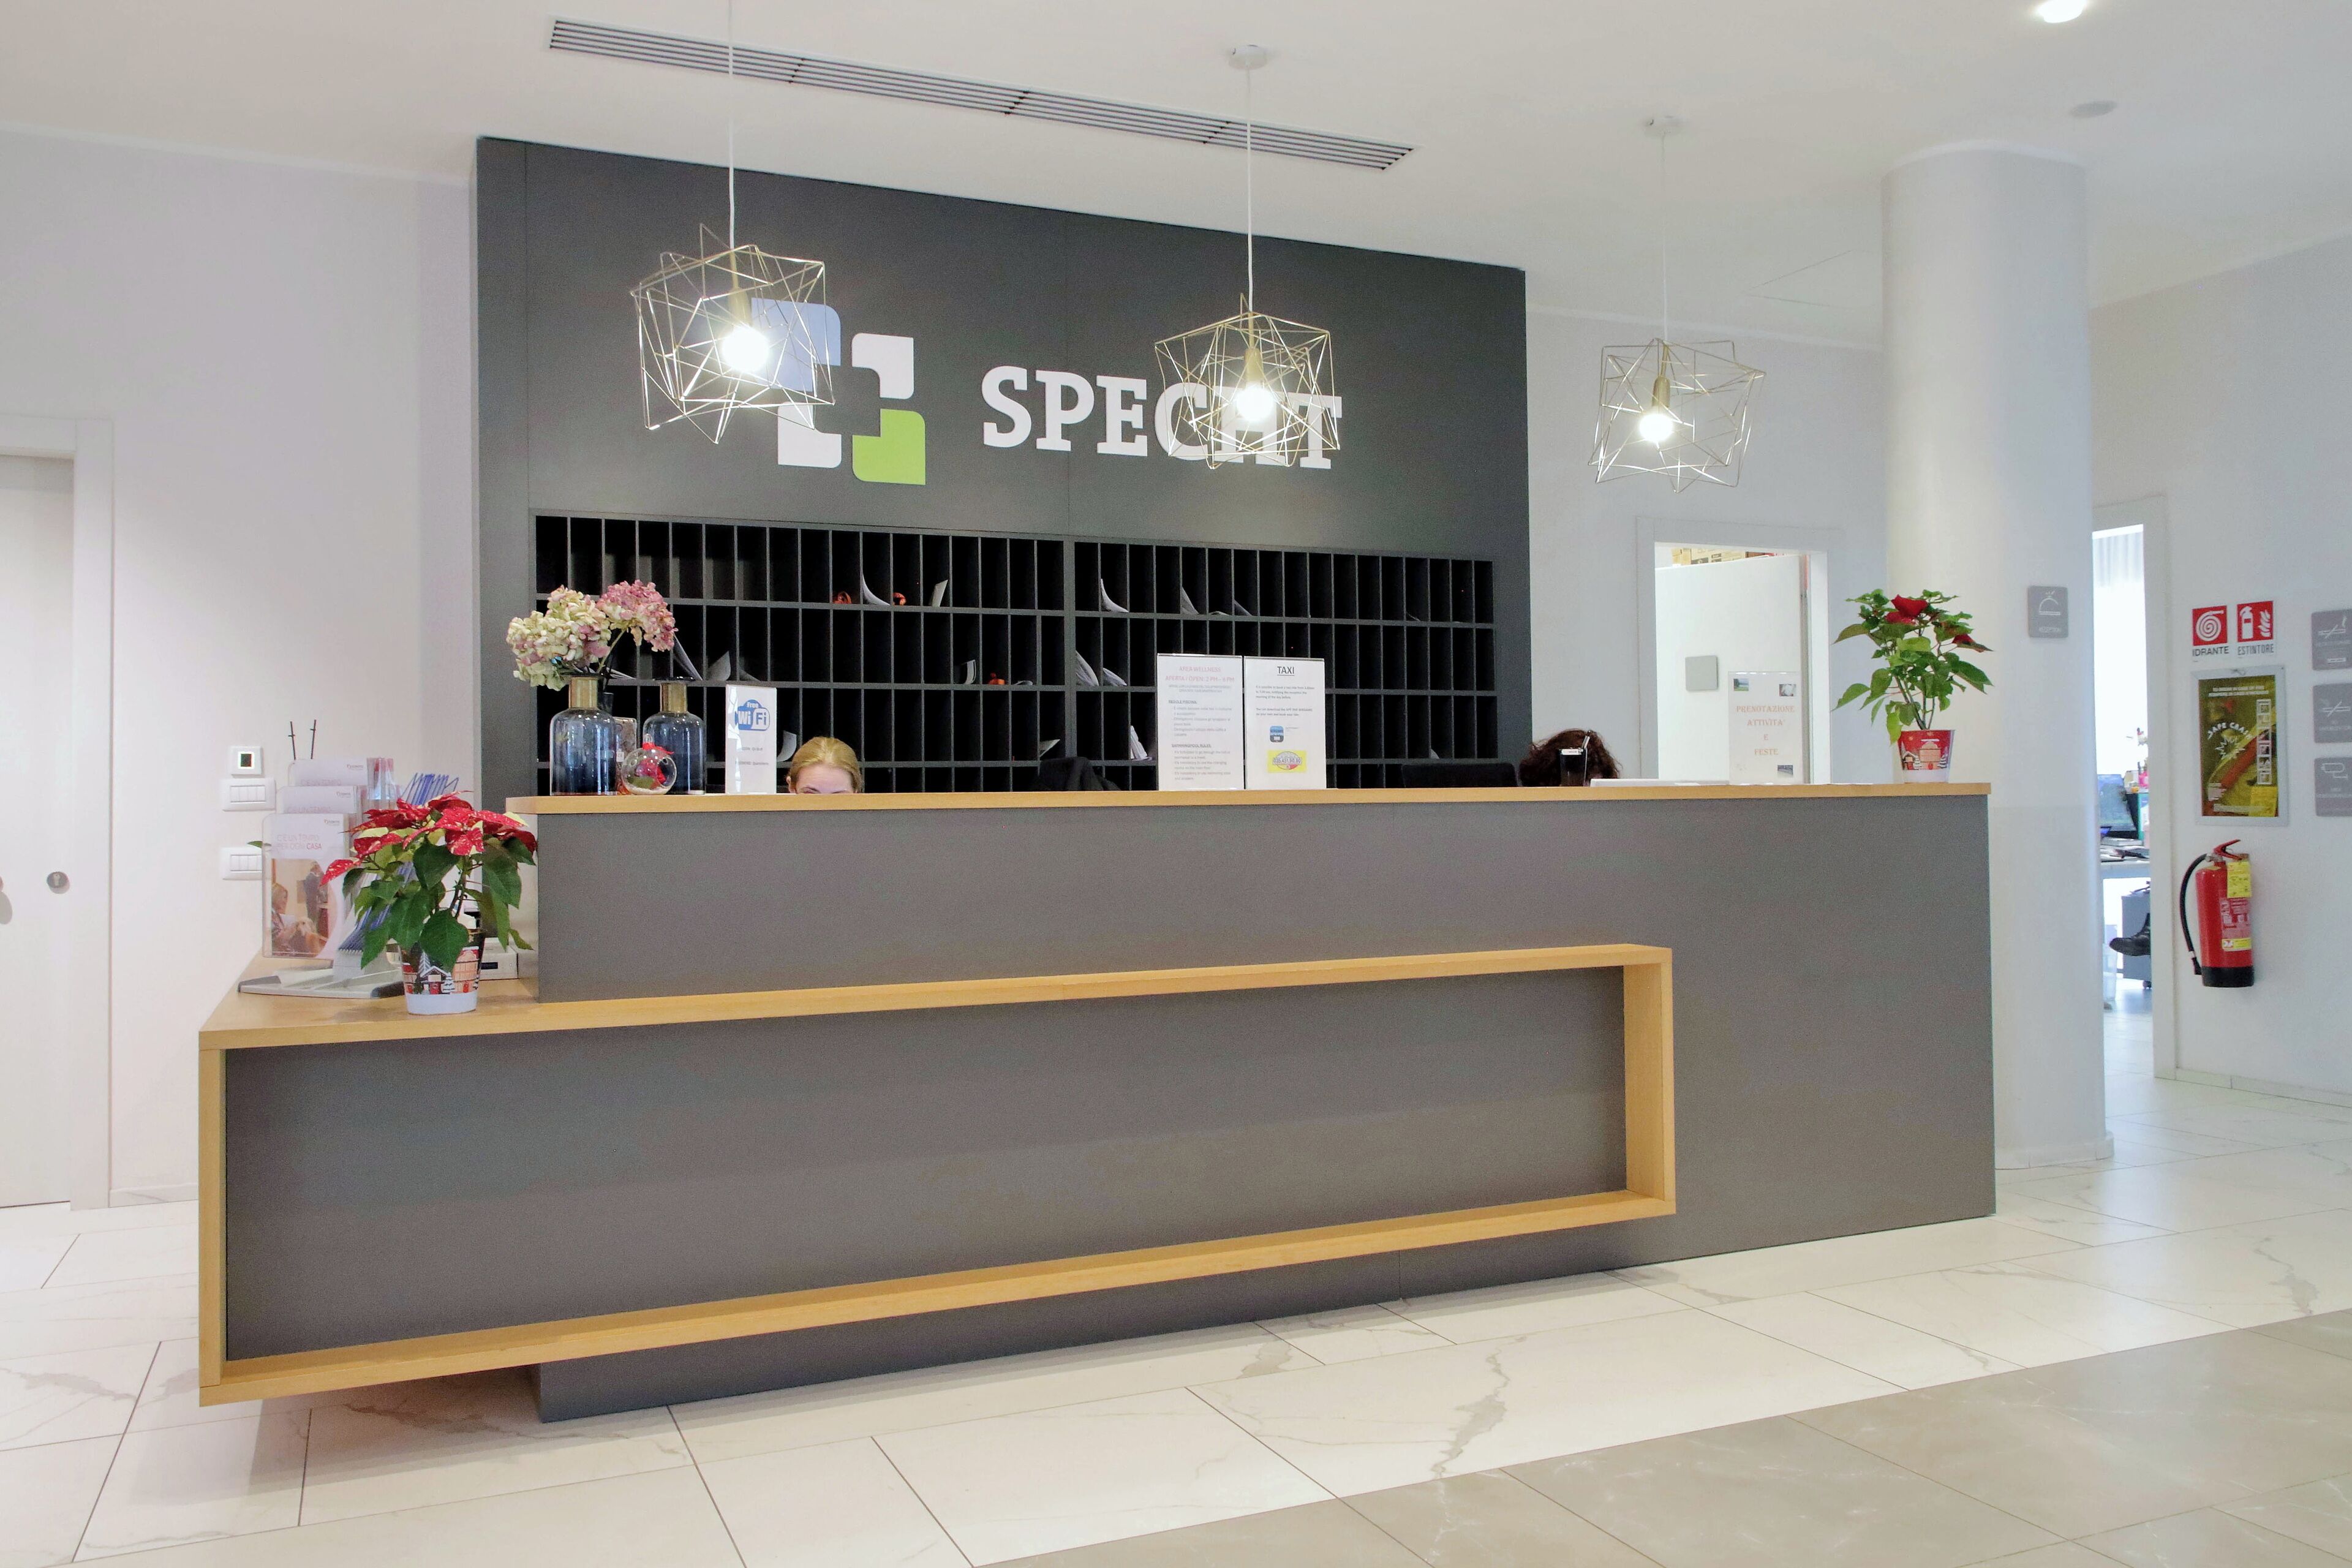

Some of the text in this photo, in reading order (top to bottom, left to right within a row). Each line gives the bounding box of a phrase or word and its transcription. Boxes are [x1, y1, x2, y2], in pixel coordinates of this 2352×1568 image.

[981, 366, 1342, 469] SPECHT
[2192, 646, 2229, 657] IDRANTE
[2237, 643, 2274, 655] ESTINTORE
[1277, 666, 1295, 674] TAXI
[738, 710, 767, 725] Wi Fi
